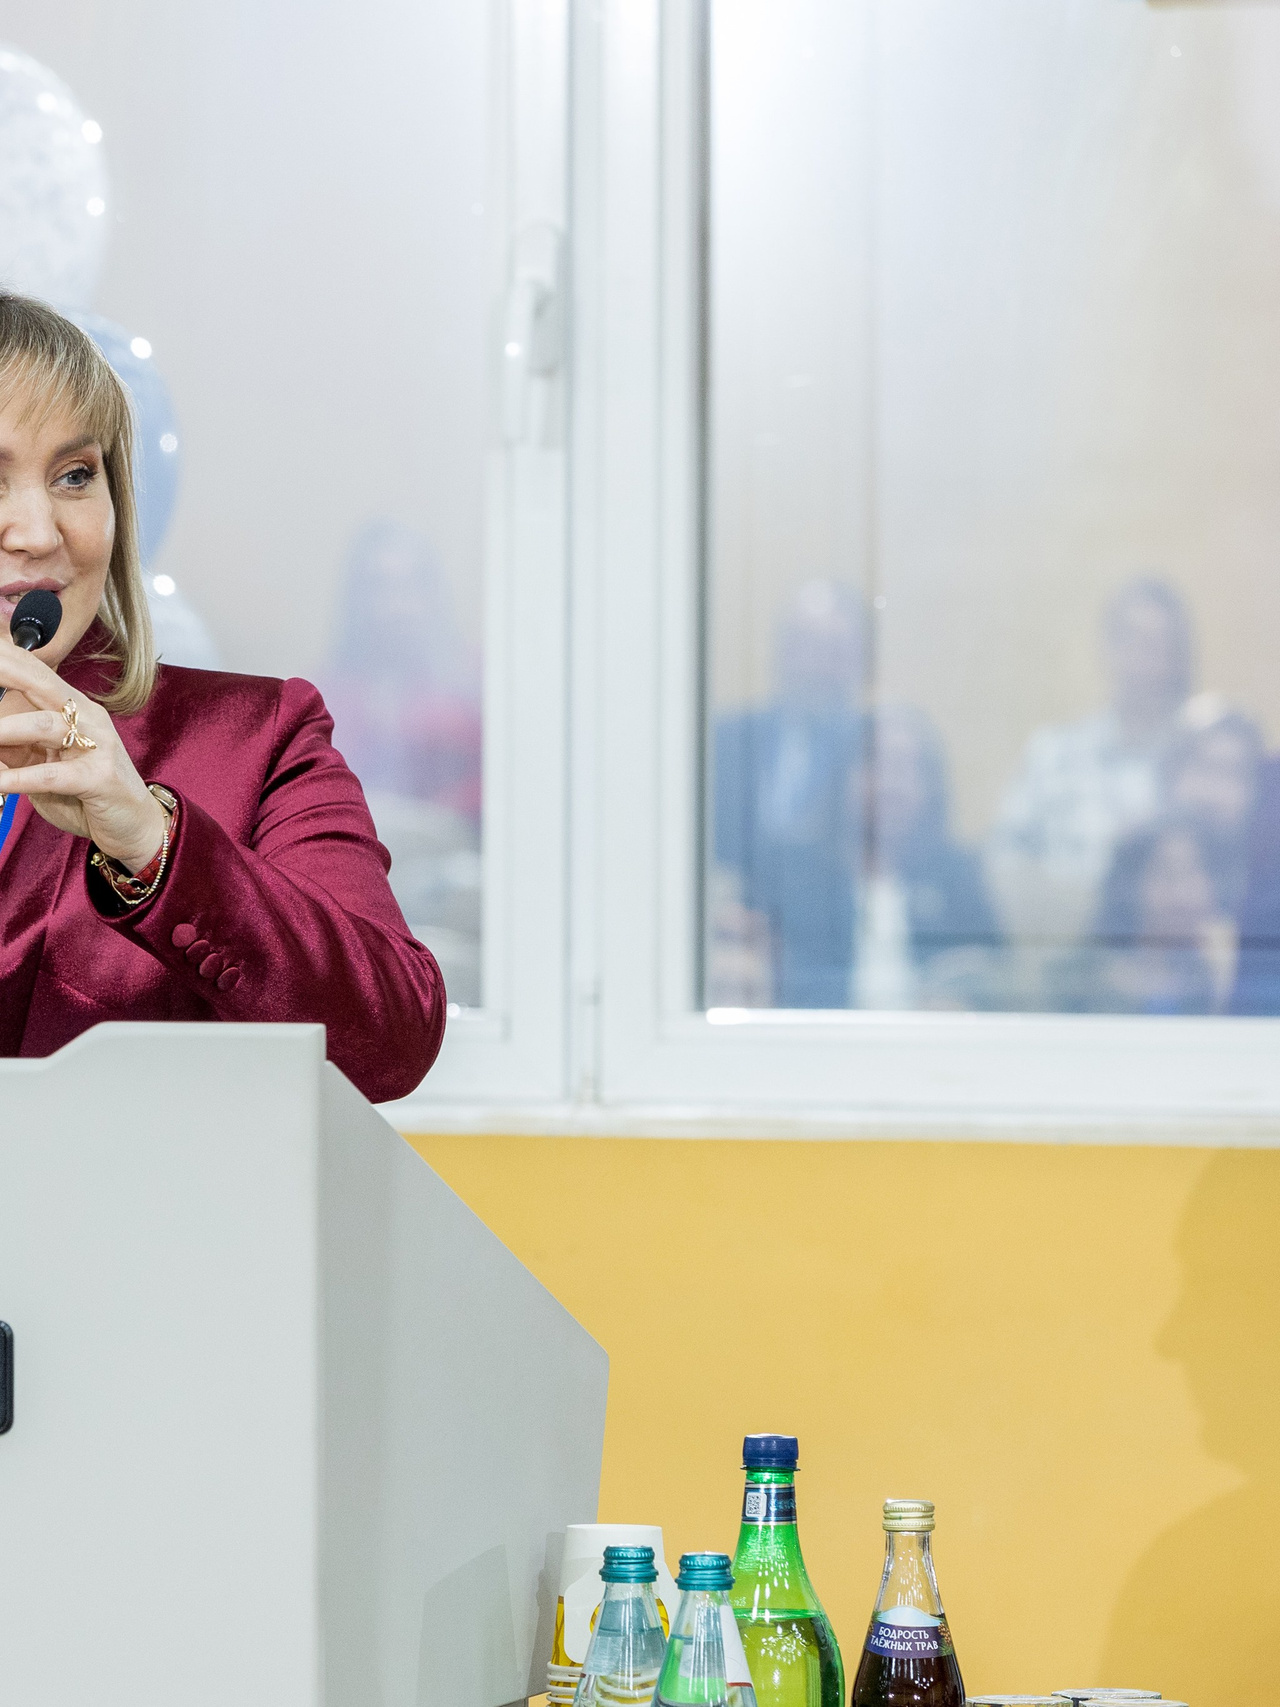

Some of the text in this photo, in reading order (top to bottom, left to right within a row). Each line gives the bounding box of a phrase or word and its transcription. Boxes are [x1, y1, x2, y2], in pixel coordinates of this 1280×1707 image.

[878, 1626, 930, 1640] БОДРОСТЬ
[870, 1635, 939, 1651] ТАЁЖНЫХ ТРАВ
